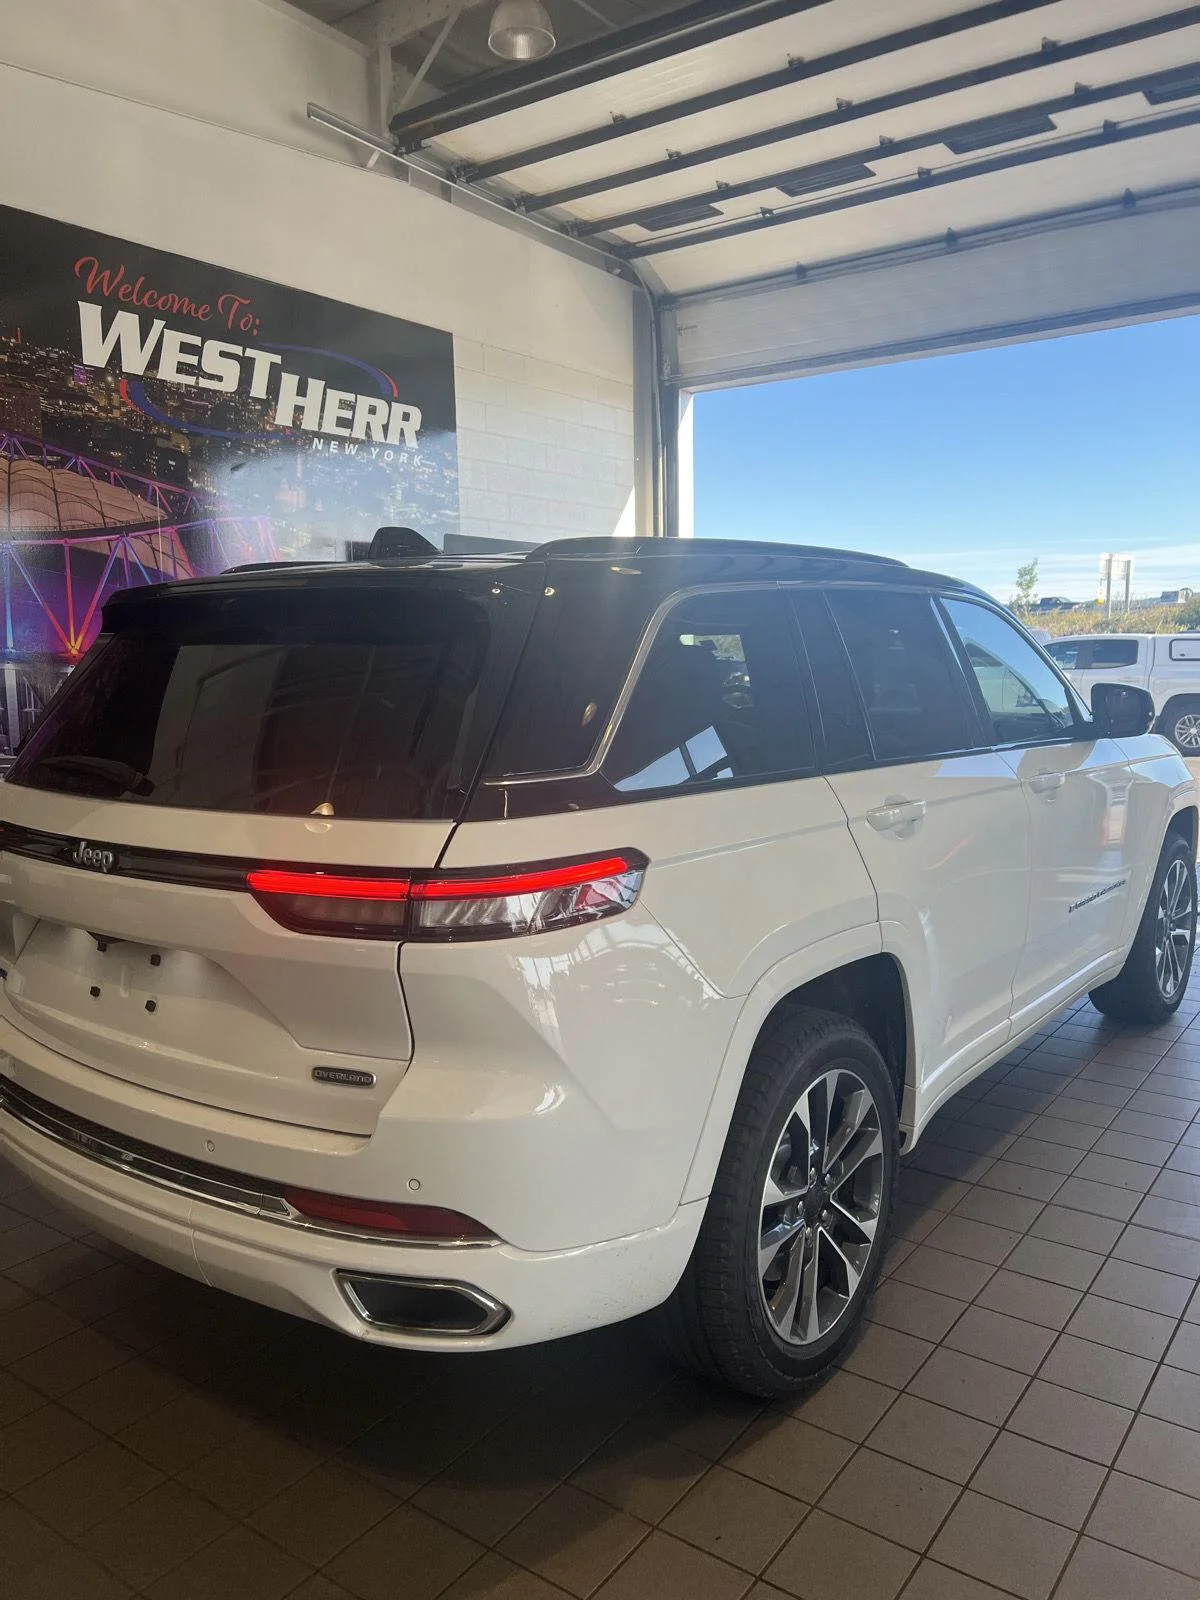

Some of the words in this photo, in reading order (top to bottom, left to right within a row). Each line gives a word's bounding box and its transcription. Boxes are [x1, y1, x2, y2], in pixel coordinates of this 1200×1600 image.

[74, 256, 213, 321] Welcome
[217, 294, 260, 336] To:
[77, 300, 282, 400] WEST
[273, 371, 423, 449] HERR
[312, 437, 359, 456] NEW
[371, 446, 423, 467] YORK
[72, 841, 113, 873] Jeep
[314, 1069, 372, 1084] OVERLAND
